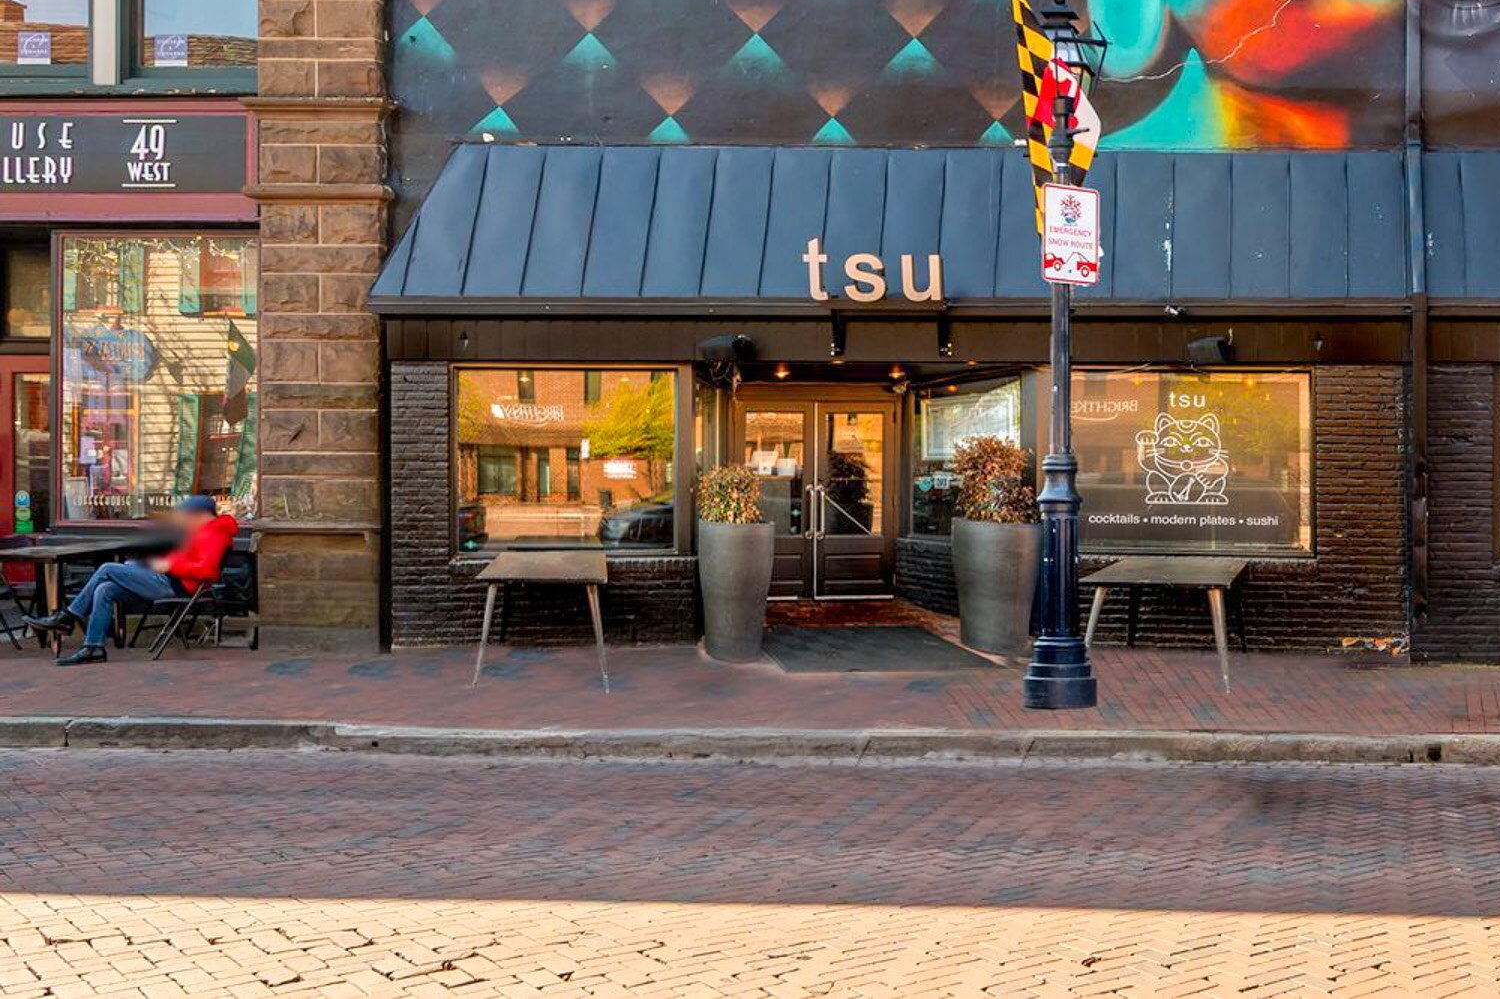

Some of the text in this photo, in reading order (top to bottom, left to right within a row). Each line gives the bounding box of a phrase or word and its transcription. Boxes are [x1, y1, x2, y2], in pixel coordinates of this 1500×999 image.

[130, 124, 166, 161] 49
[127, 162, 171, 182] WEST
[1049, 225, 1092, 238] EMERGENCY
[1048, 237, 1093, 251] SNOW ROUTE
[802, 237, 943, 303] tsu
[1169, 391, 1206, 408] tsu
[1088, 513, 1279, 528] cocktails modern plates sushi
